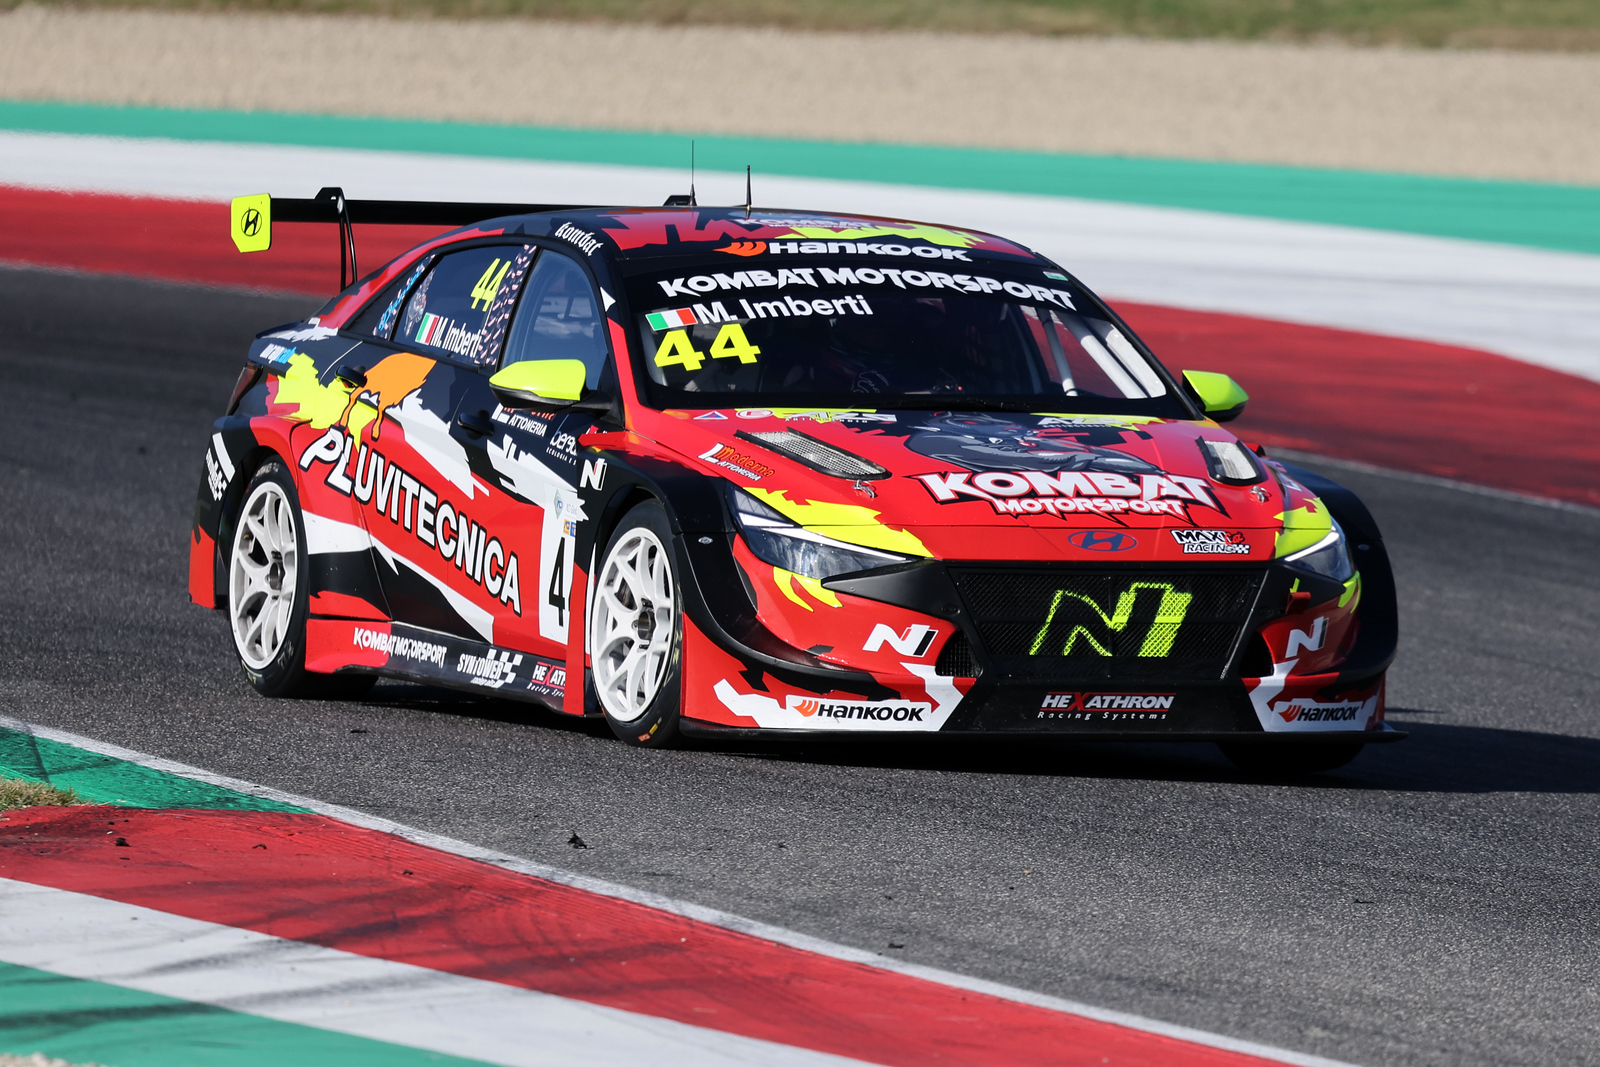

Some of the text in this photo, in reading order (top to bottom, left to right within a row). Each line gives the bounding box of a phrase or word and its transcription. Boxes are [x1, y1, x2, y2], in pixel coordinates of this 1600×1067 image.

[470, 257, 512, 312] 44
[657, 267, 1077, 312] KOMBAT MOTORSPORT
[692, 294, 874, 325] M. Imberti
[442, 318, 483, 359] Imberti
[653, 323, 762, 372] 44
[918, 470, 1218, 512] KOMBAT
[992, 497, 1192, 519] MOTORSPORT
[299, 424, 522, 617] PLUVITECNICA
[1183, 543, 1237, 554] RACING
[353, 626, 448, 669] KOMBAT MOTORSPORT
[1037, 711, 1168, 721] Racing Systems
[1041, 692, 1175, 711] HEXATHRON
